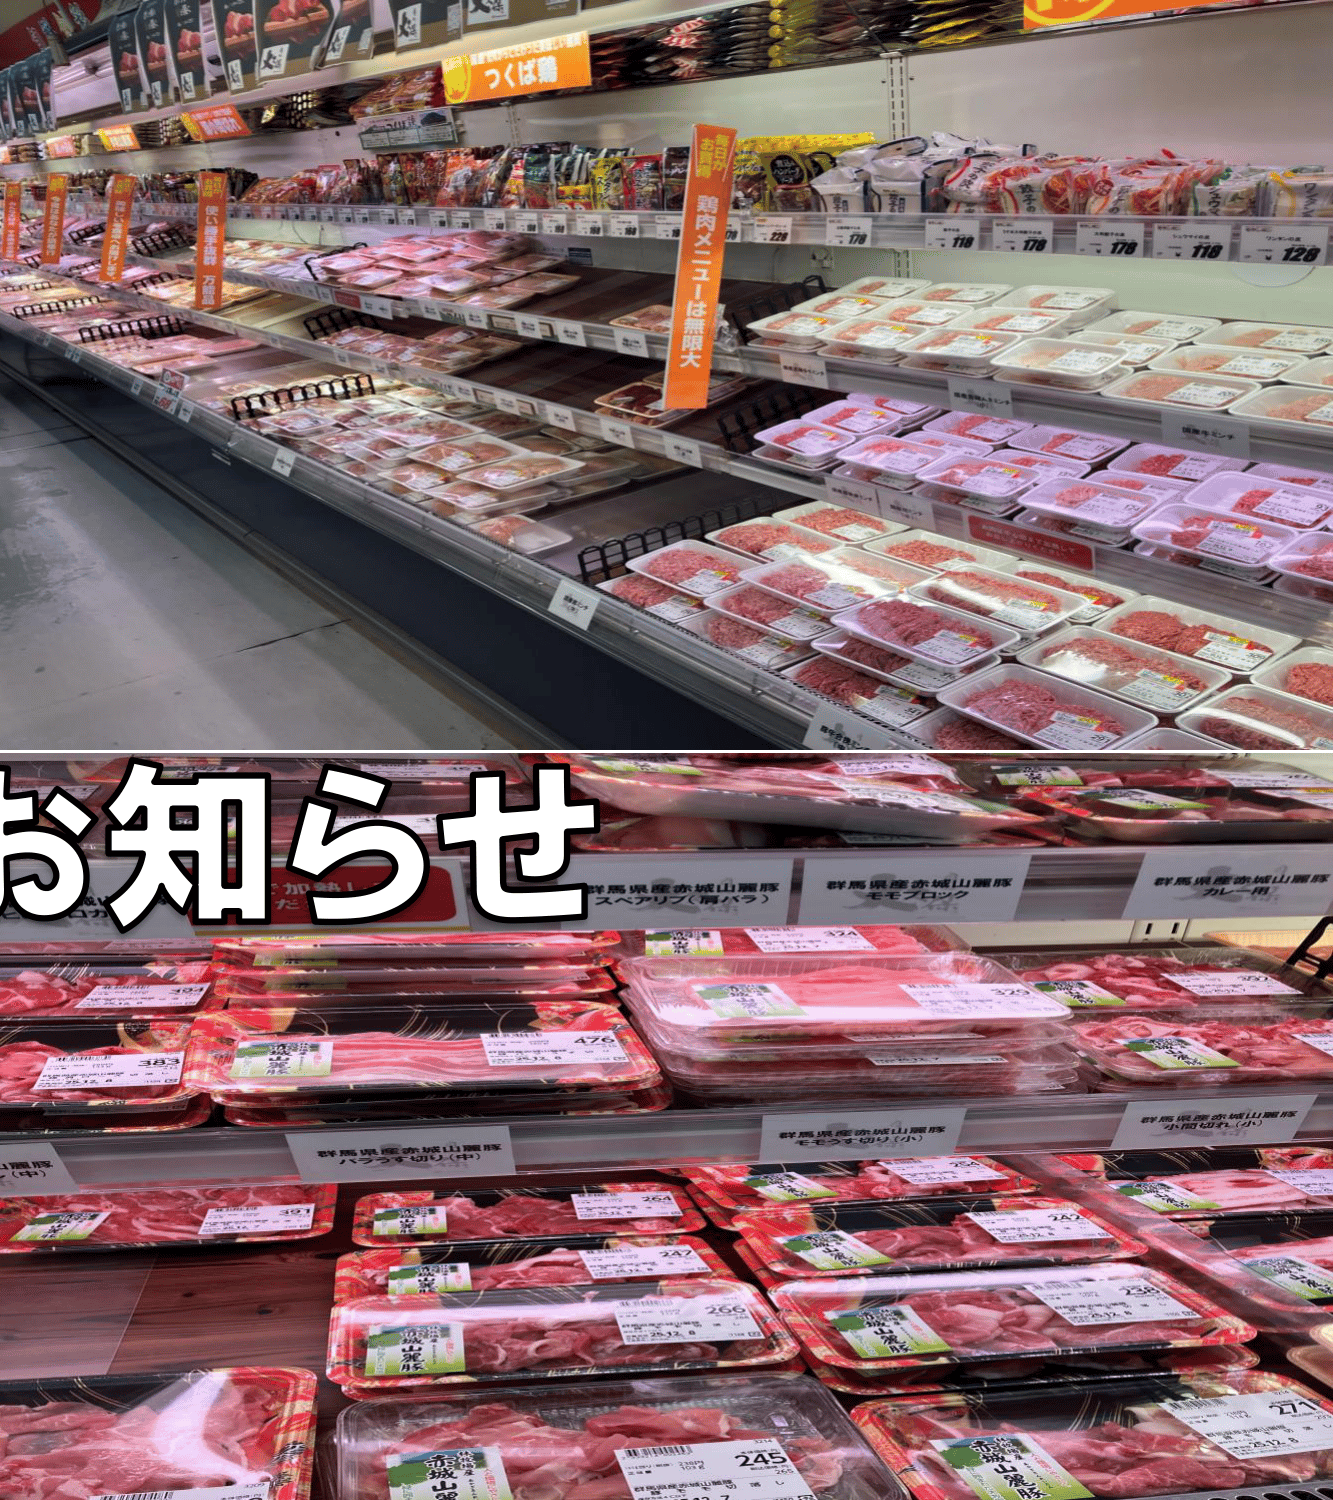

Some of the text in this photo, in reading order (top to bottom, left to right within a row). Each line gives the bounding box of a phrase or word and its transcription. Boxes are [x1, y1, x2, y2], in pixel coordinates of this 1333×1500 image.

[849, 234, 867, 244] 178
[952, 236, 974, 248] 118
[1022, 239, 1047, 251] 178
[1110, 241, 1138, 255] 178
[1191, 244, 1223, 259] 118
[1282, 247, 1321, 262] 128
[679, 195, 719, 368] 鶏肉メニューは無限大
[825, 876, 1013, 892] 群馬県産赤城山麗豚
[1153, 873, 1331, 888] 群馬県産赤城山麗豚
[587, 882, 780, 895] 群馬県産赤城山麗豚
[867, 888, 970, 901] モモブロック
[1203, 885, 1270, 897] カレー用
[595, 894, 769, 906] スペアリブ(肩バラ)
[137, 1058, 181, 1068] 383
[1140, 1110, 1298, 1125] 群馬県産赤城山麗豚
[1164, 1119, 1263, 1131] 小間切れ(小)
[778, 1125, 946, 1140] 群馬県産赤城山麗豚
[794, 1134, 924, 1147] モモうす切り(小)
[317, 1143, 502, 1159] 群馬県産赤城山麗豚
[339, 1152, 481, 1166] バラうす切り(中)
[1047, 1213, 1083, 1222] 242
[1119, 1286, 1160, 1295] 238
[705, 1306, 746, 1315] 266
[1268, 1401, 1317, 1415] 271
[734, 1452, 788, 1467] 245
[970, 1440, 1051, 1499] 赤城山麗豚
